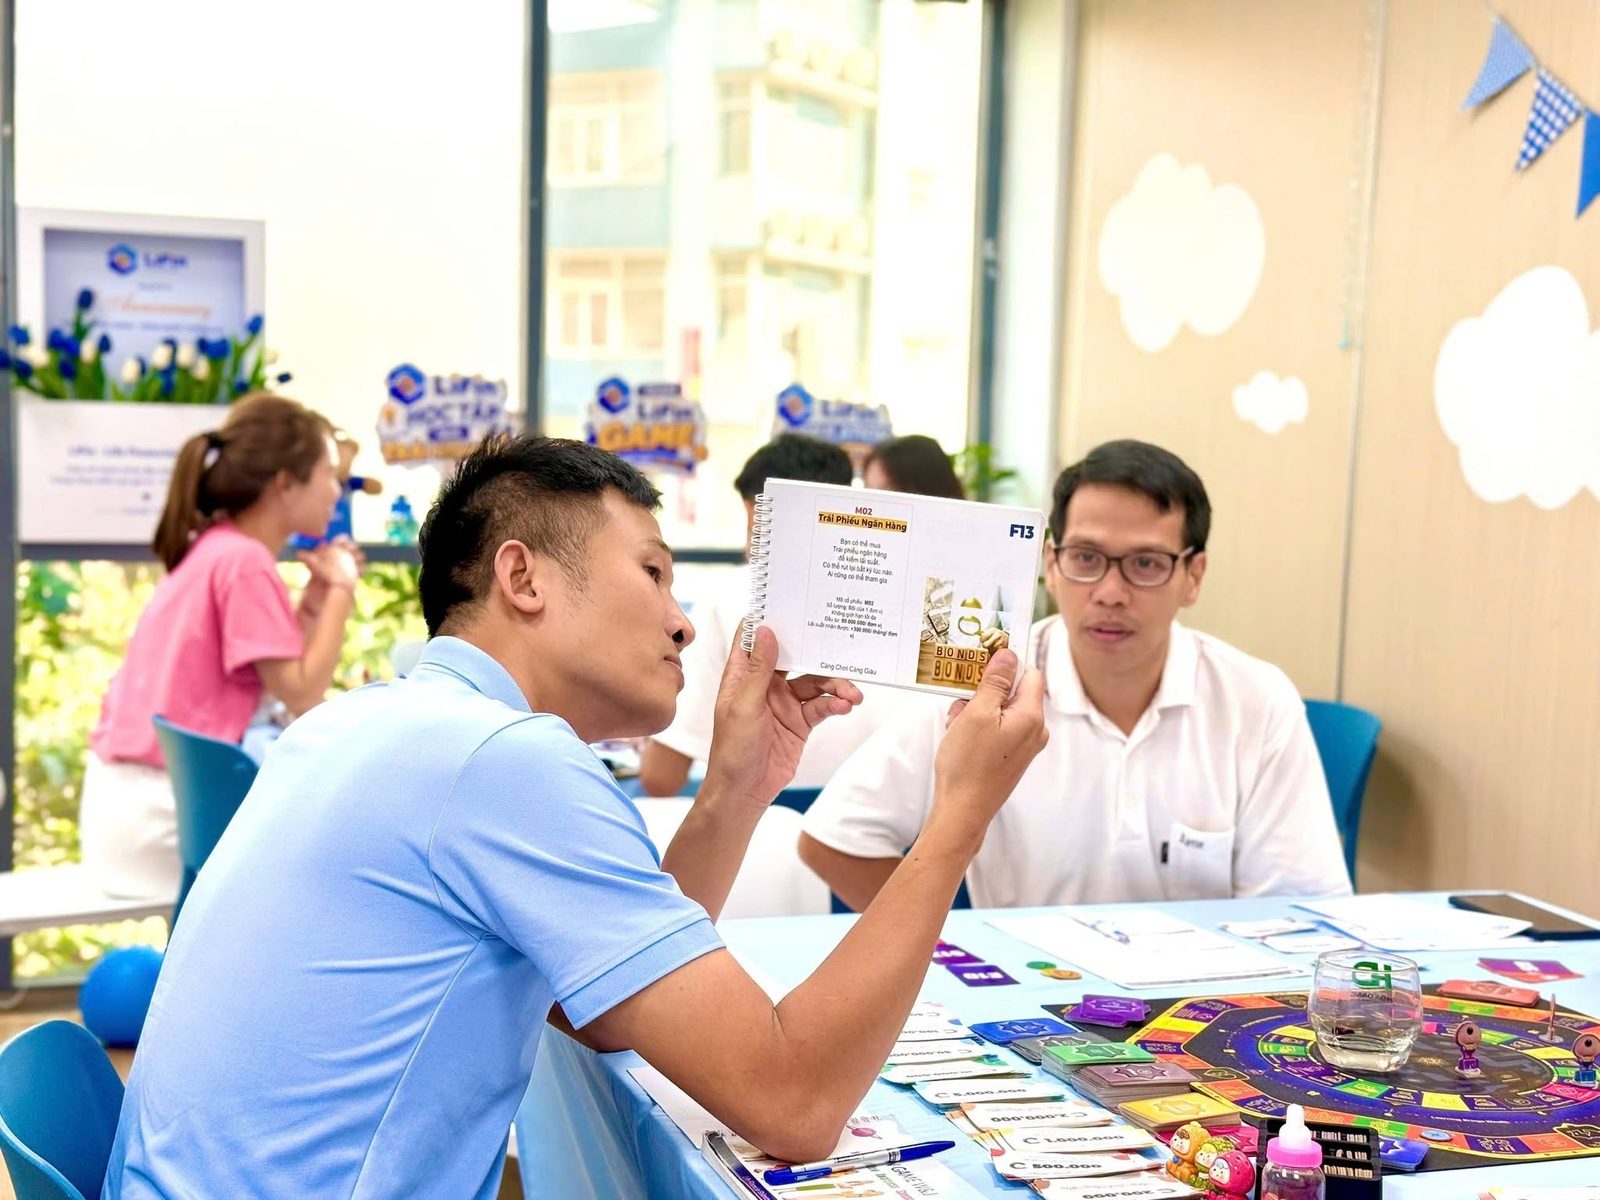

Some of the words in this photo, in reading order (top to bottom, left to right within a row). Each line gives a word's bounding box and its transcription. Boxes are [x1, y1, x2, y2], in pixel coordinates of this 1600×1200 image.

[434, 375, 497, 396] LiFin
[638, 401, 692, 418] LiFin
[855, 506, 873, 515] M02
[818, 513, 834, 523] Trái
[836, 514, 859, 526] Phiếu
[861, 518, 883, 529] Ngân
[885, 519, 907, 533] Hàng
[1009, 523, 1035, 539] F13
[936, 647, 986, 662] BONDS
[990, 1113, 1068, 1123] 2.000.000
[1044, 1135, 1125, 1144] 1.000.000
[1032, 1162, 1102, 1170] 500.000
